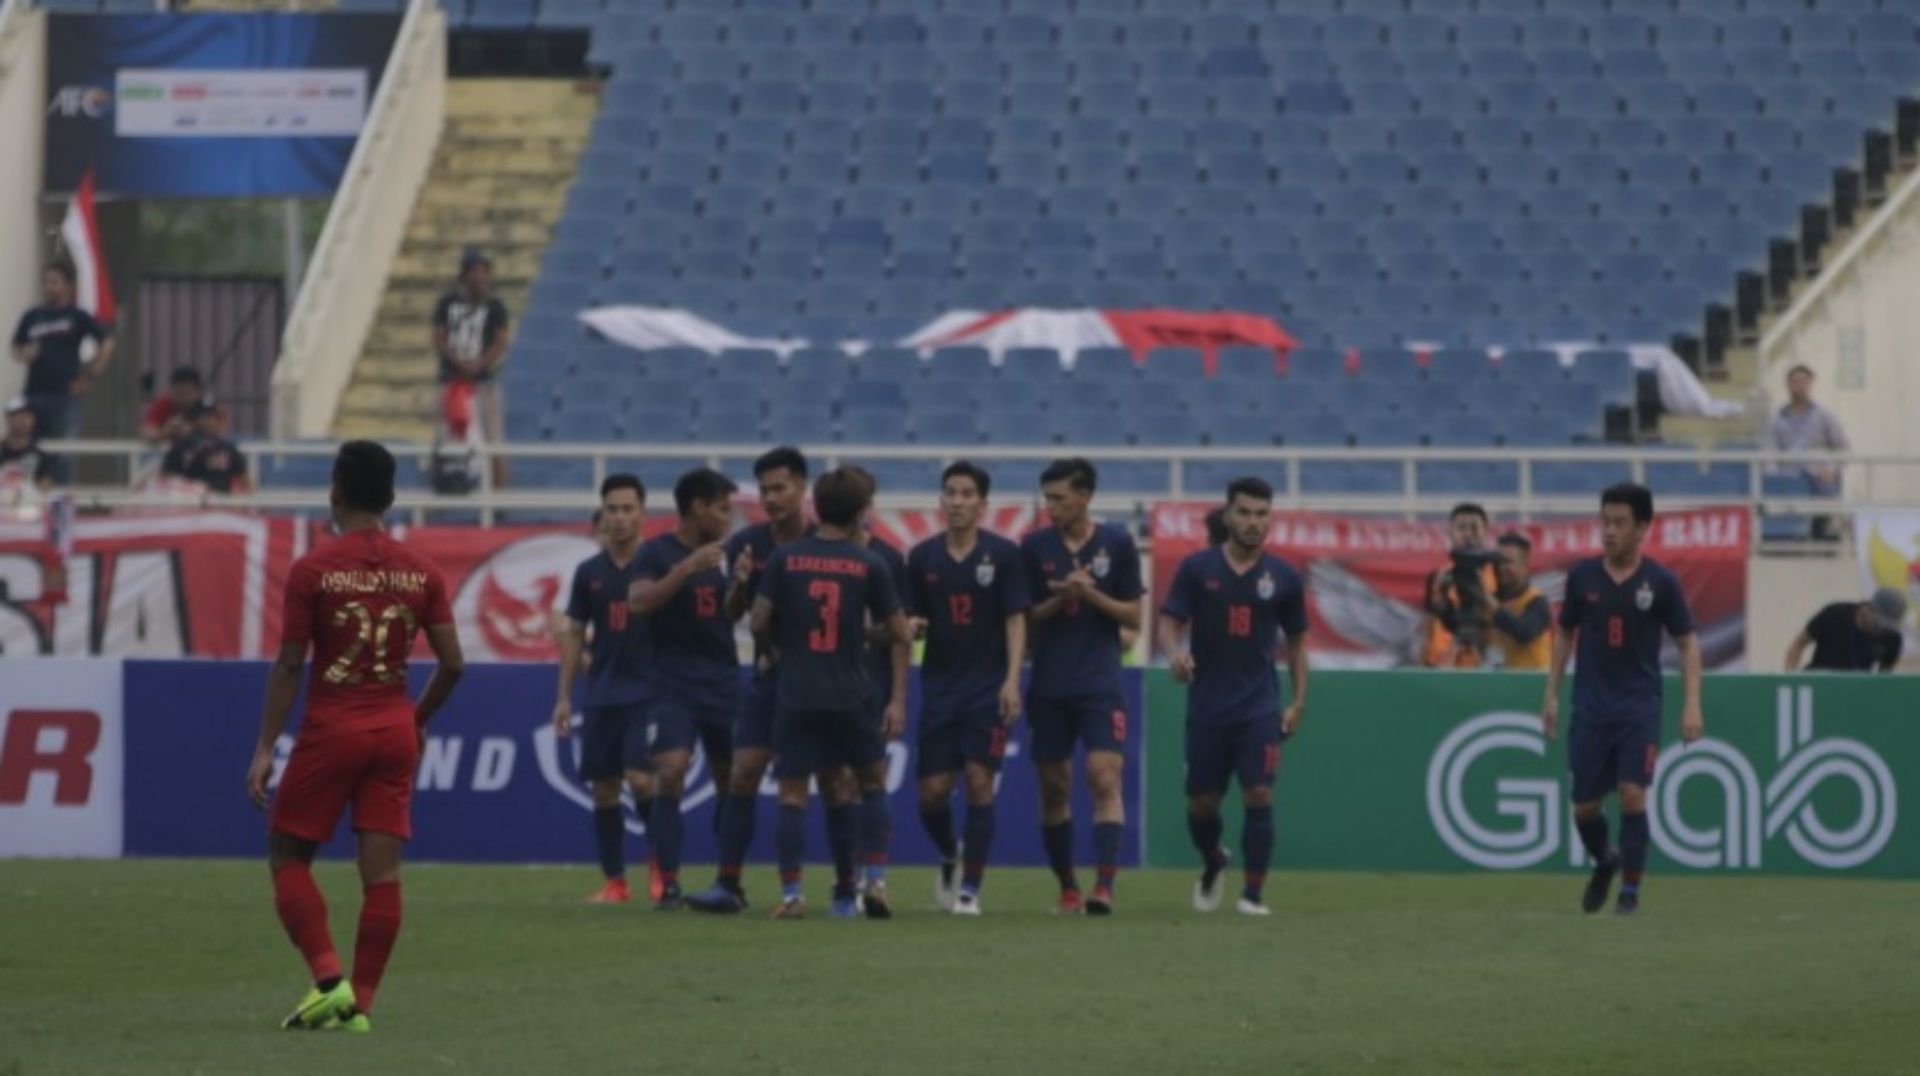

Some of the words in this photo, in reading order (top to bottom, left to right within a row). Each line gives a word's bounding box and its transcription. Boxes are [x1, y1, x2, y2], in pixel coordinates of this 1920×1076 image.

[50, 86, 110, 118] AFC
[1662, 512, 1739, 548] BALI
[390, 571, 427, 592] HAAY
[697, 586, 716, 618] 15
[808, 580, 840, 652] 3
[950, 593, 973, 625] 12
[324, 601, 416, 683] 20
[1426, 685, 1897, 869] Gab
